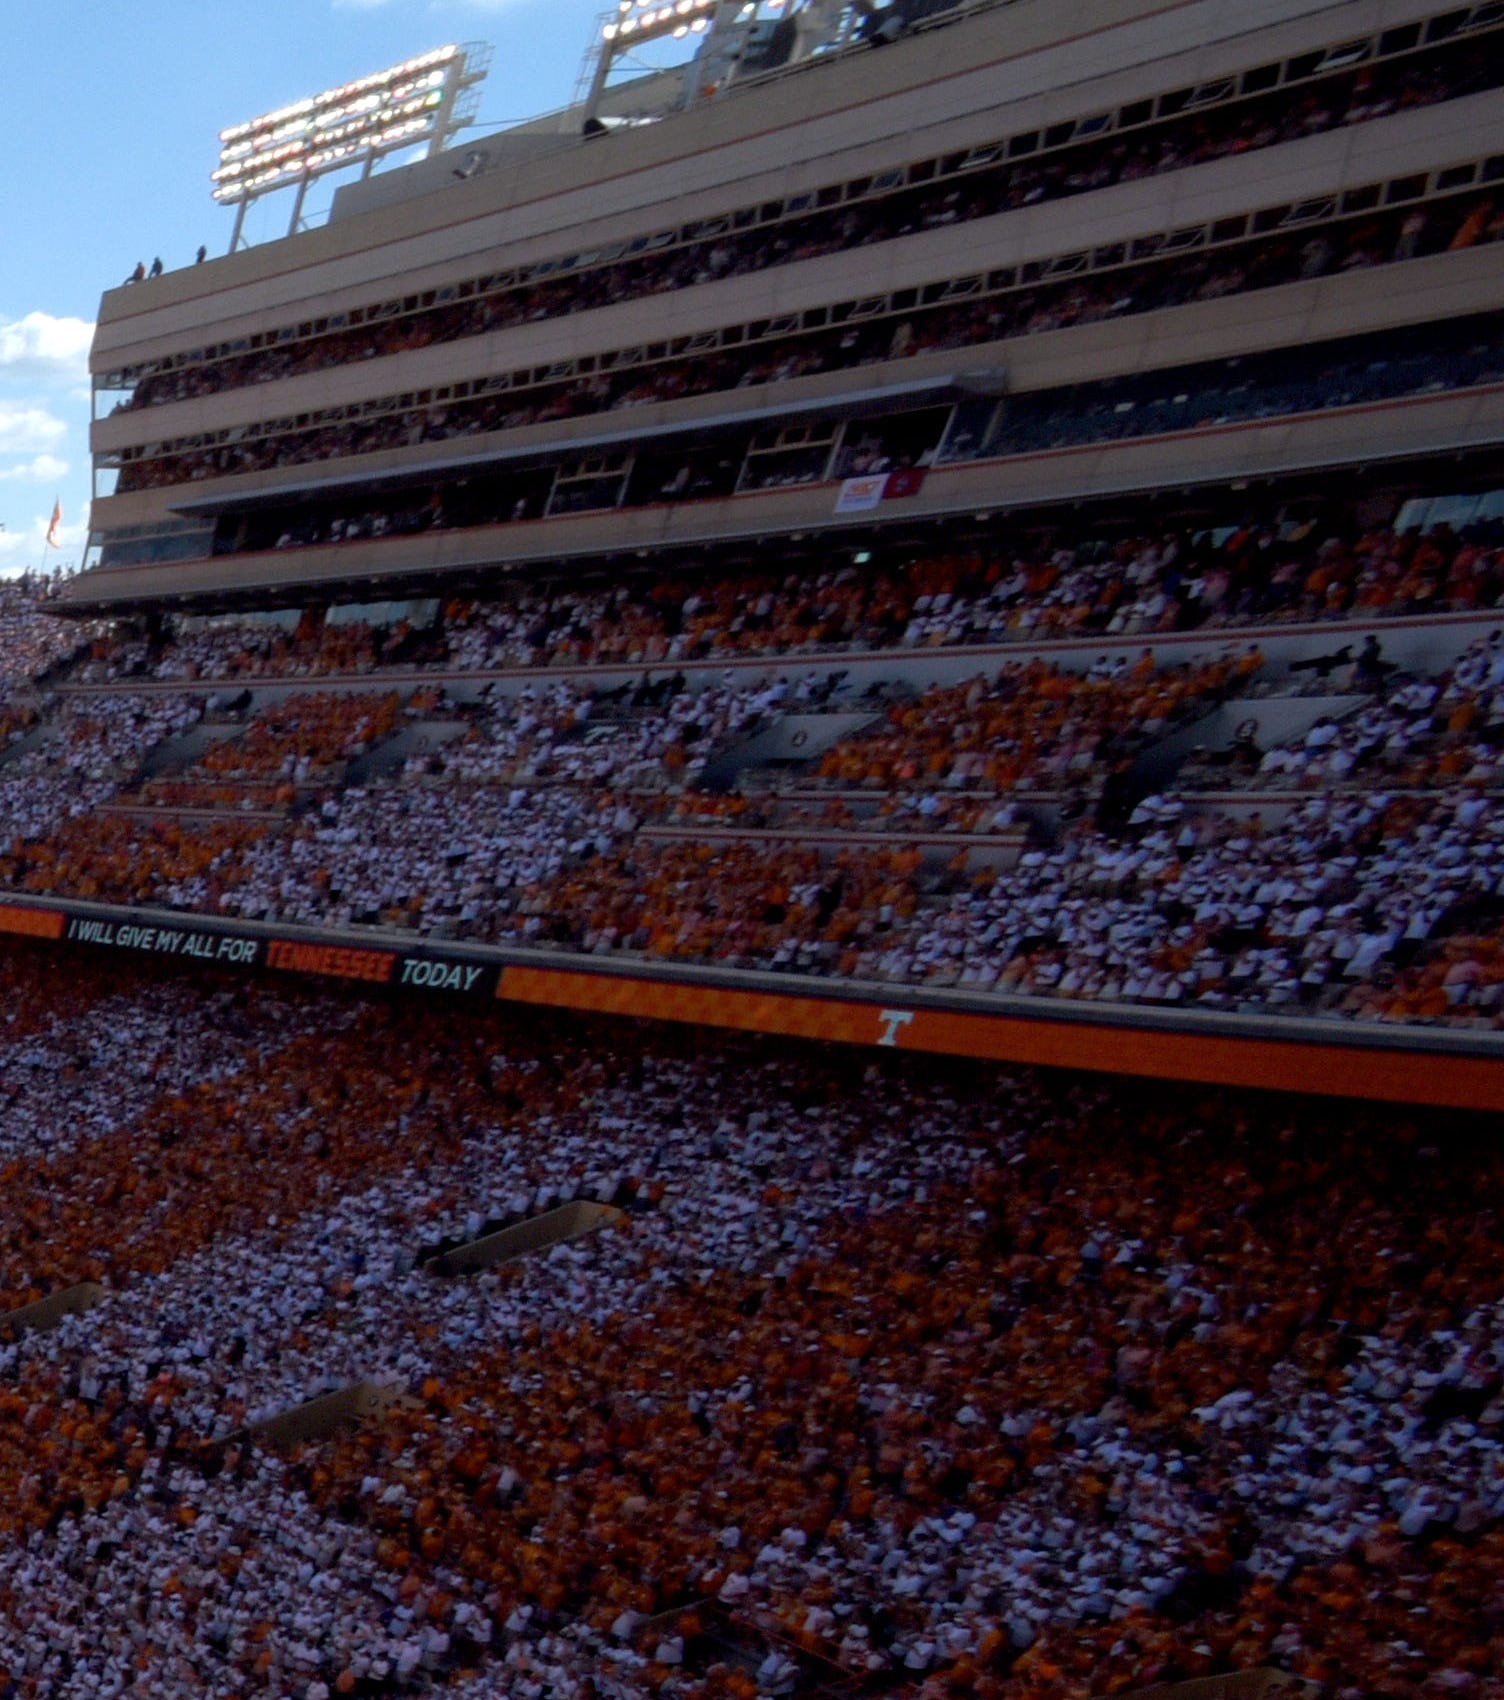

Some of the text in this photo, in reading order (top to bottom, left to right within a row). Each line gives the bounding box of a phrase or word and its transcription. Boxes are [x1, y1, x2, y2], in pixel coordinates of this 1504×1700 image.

[68, 918, 483, 991] I WILL GIVE MY ALL FOR TENNESSEE TODAY
